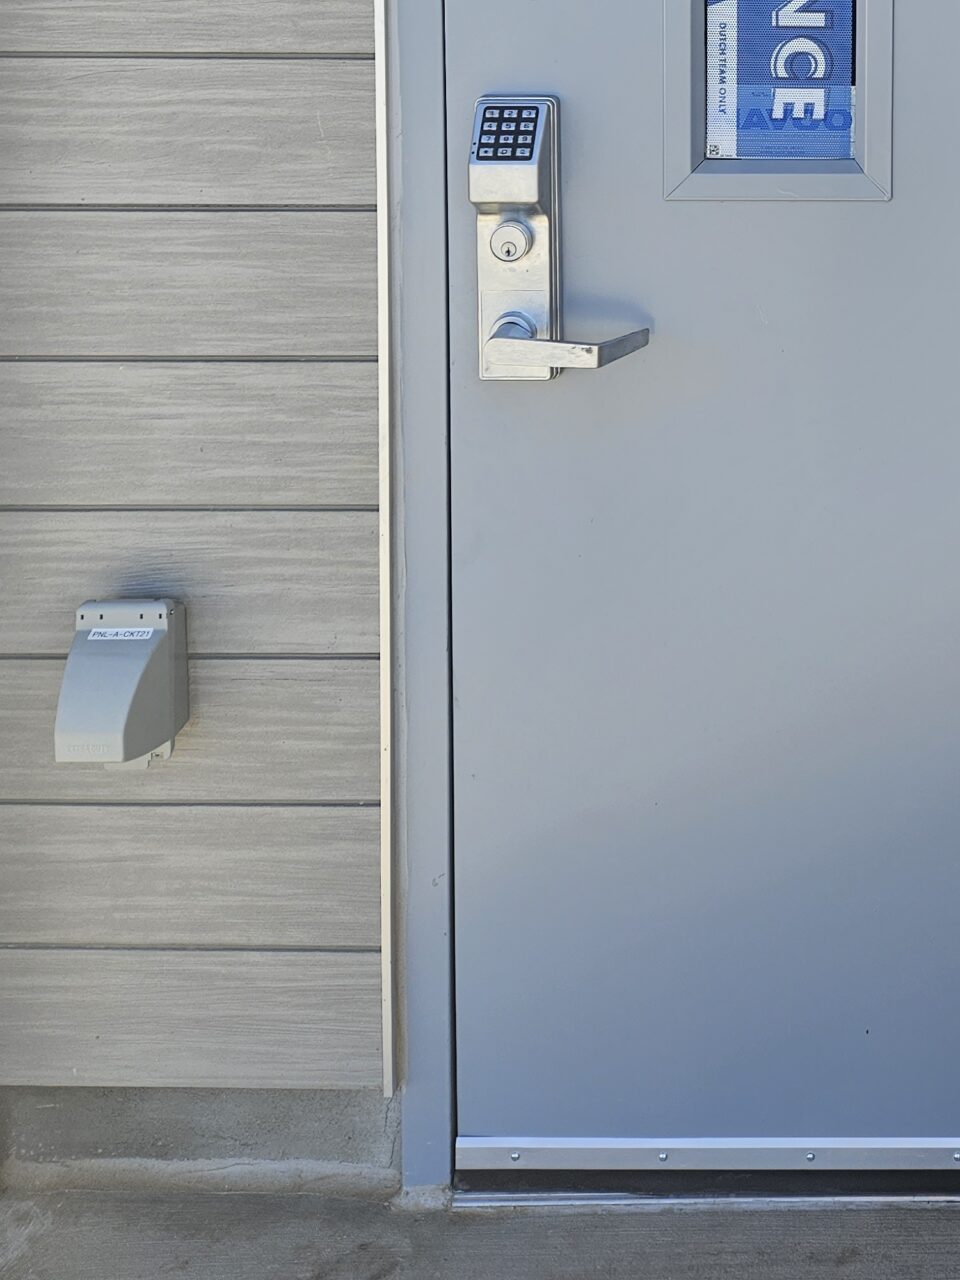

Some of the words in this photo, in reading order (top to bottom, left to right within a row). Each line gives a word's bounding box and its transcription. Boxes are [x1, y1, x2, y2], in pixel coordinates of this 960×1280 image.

[719, 22, 727, 56] DUTCH
[719, 58, 727, 85] TEAM
[719, 87, 727, 115] ONLY
